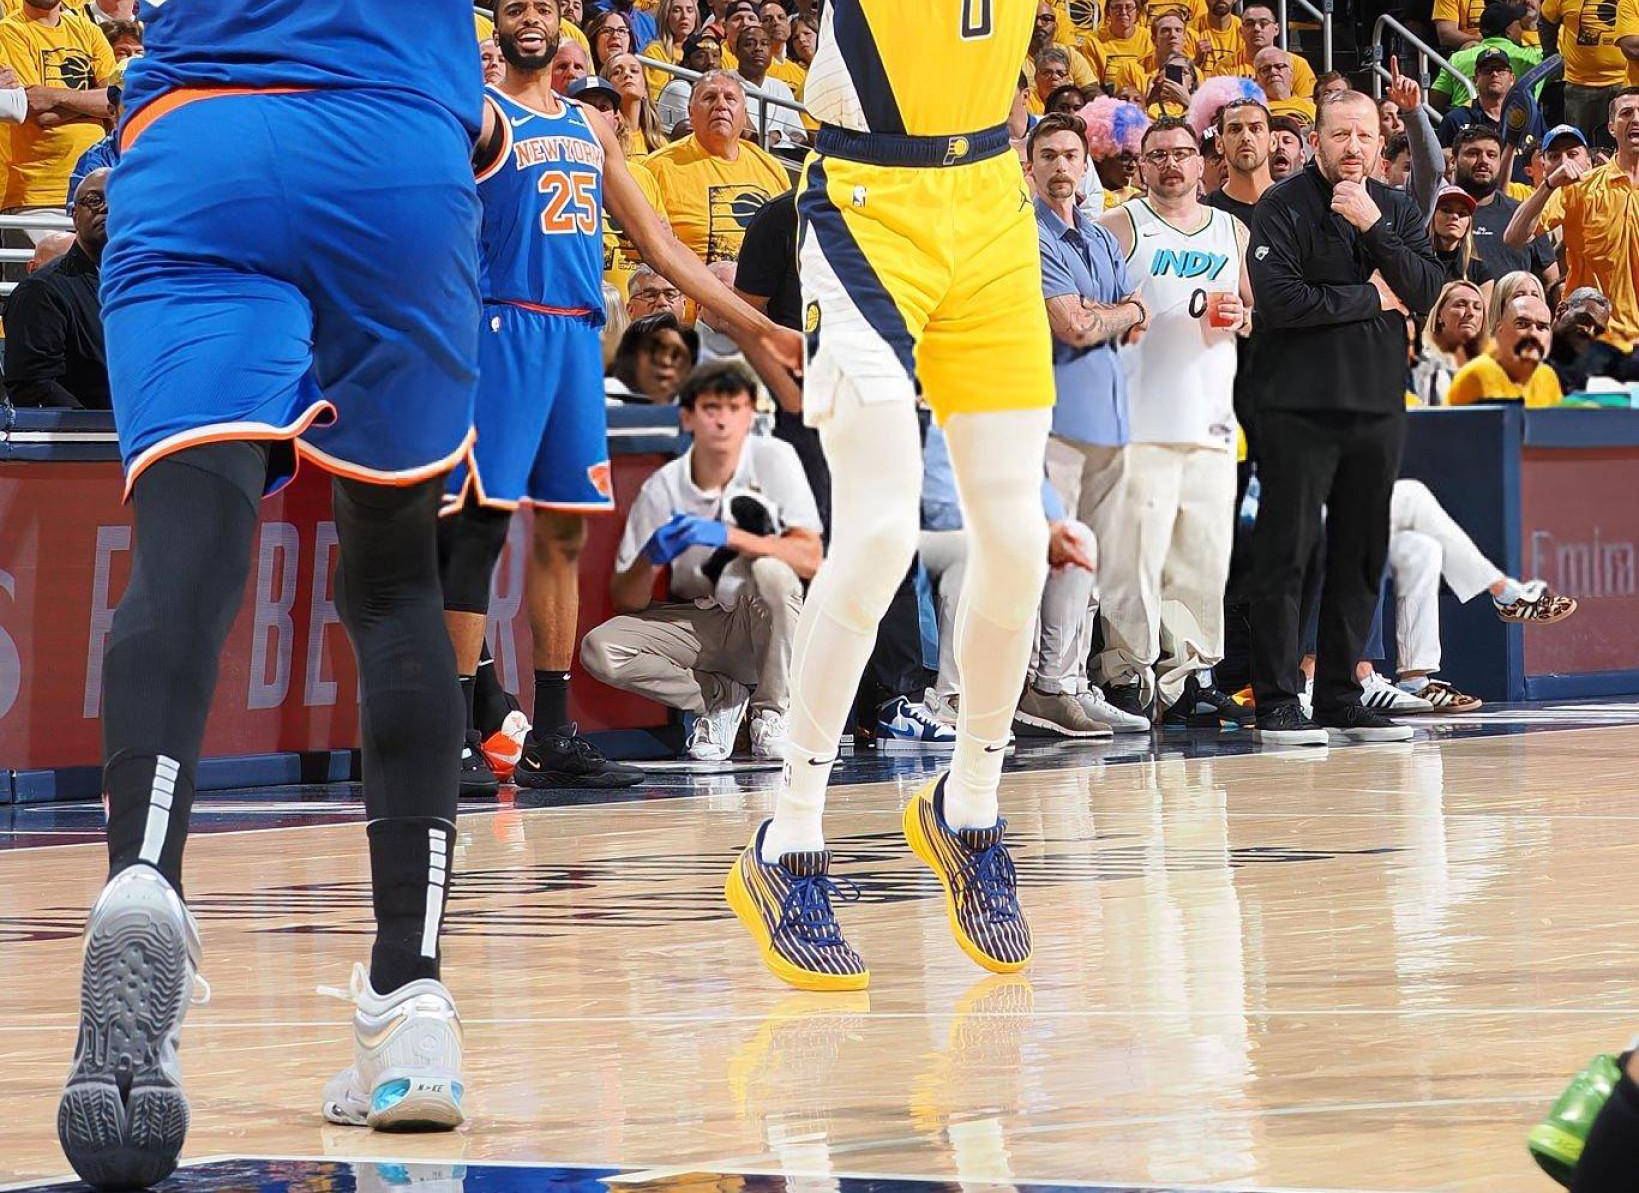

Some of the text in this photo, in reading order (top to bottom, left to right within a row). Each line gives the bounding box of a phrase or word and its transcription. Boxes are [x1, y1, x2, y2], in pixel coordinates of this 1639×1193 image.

[513, 136, 560, 171] NEW
[537, 170, 597, 235] 25
[1150, 249, 1229, 280] INDY
